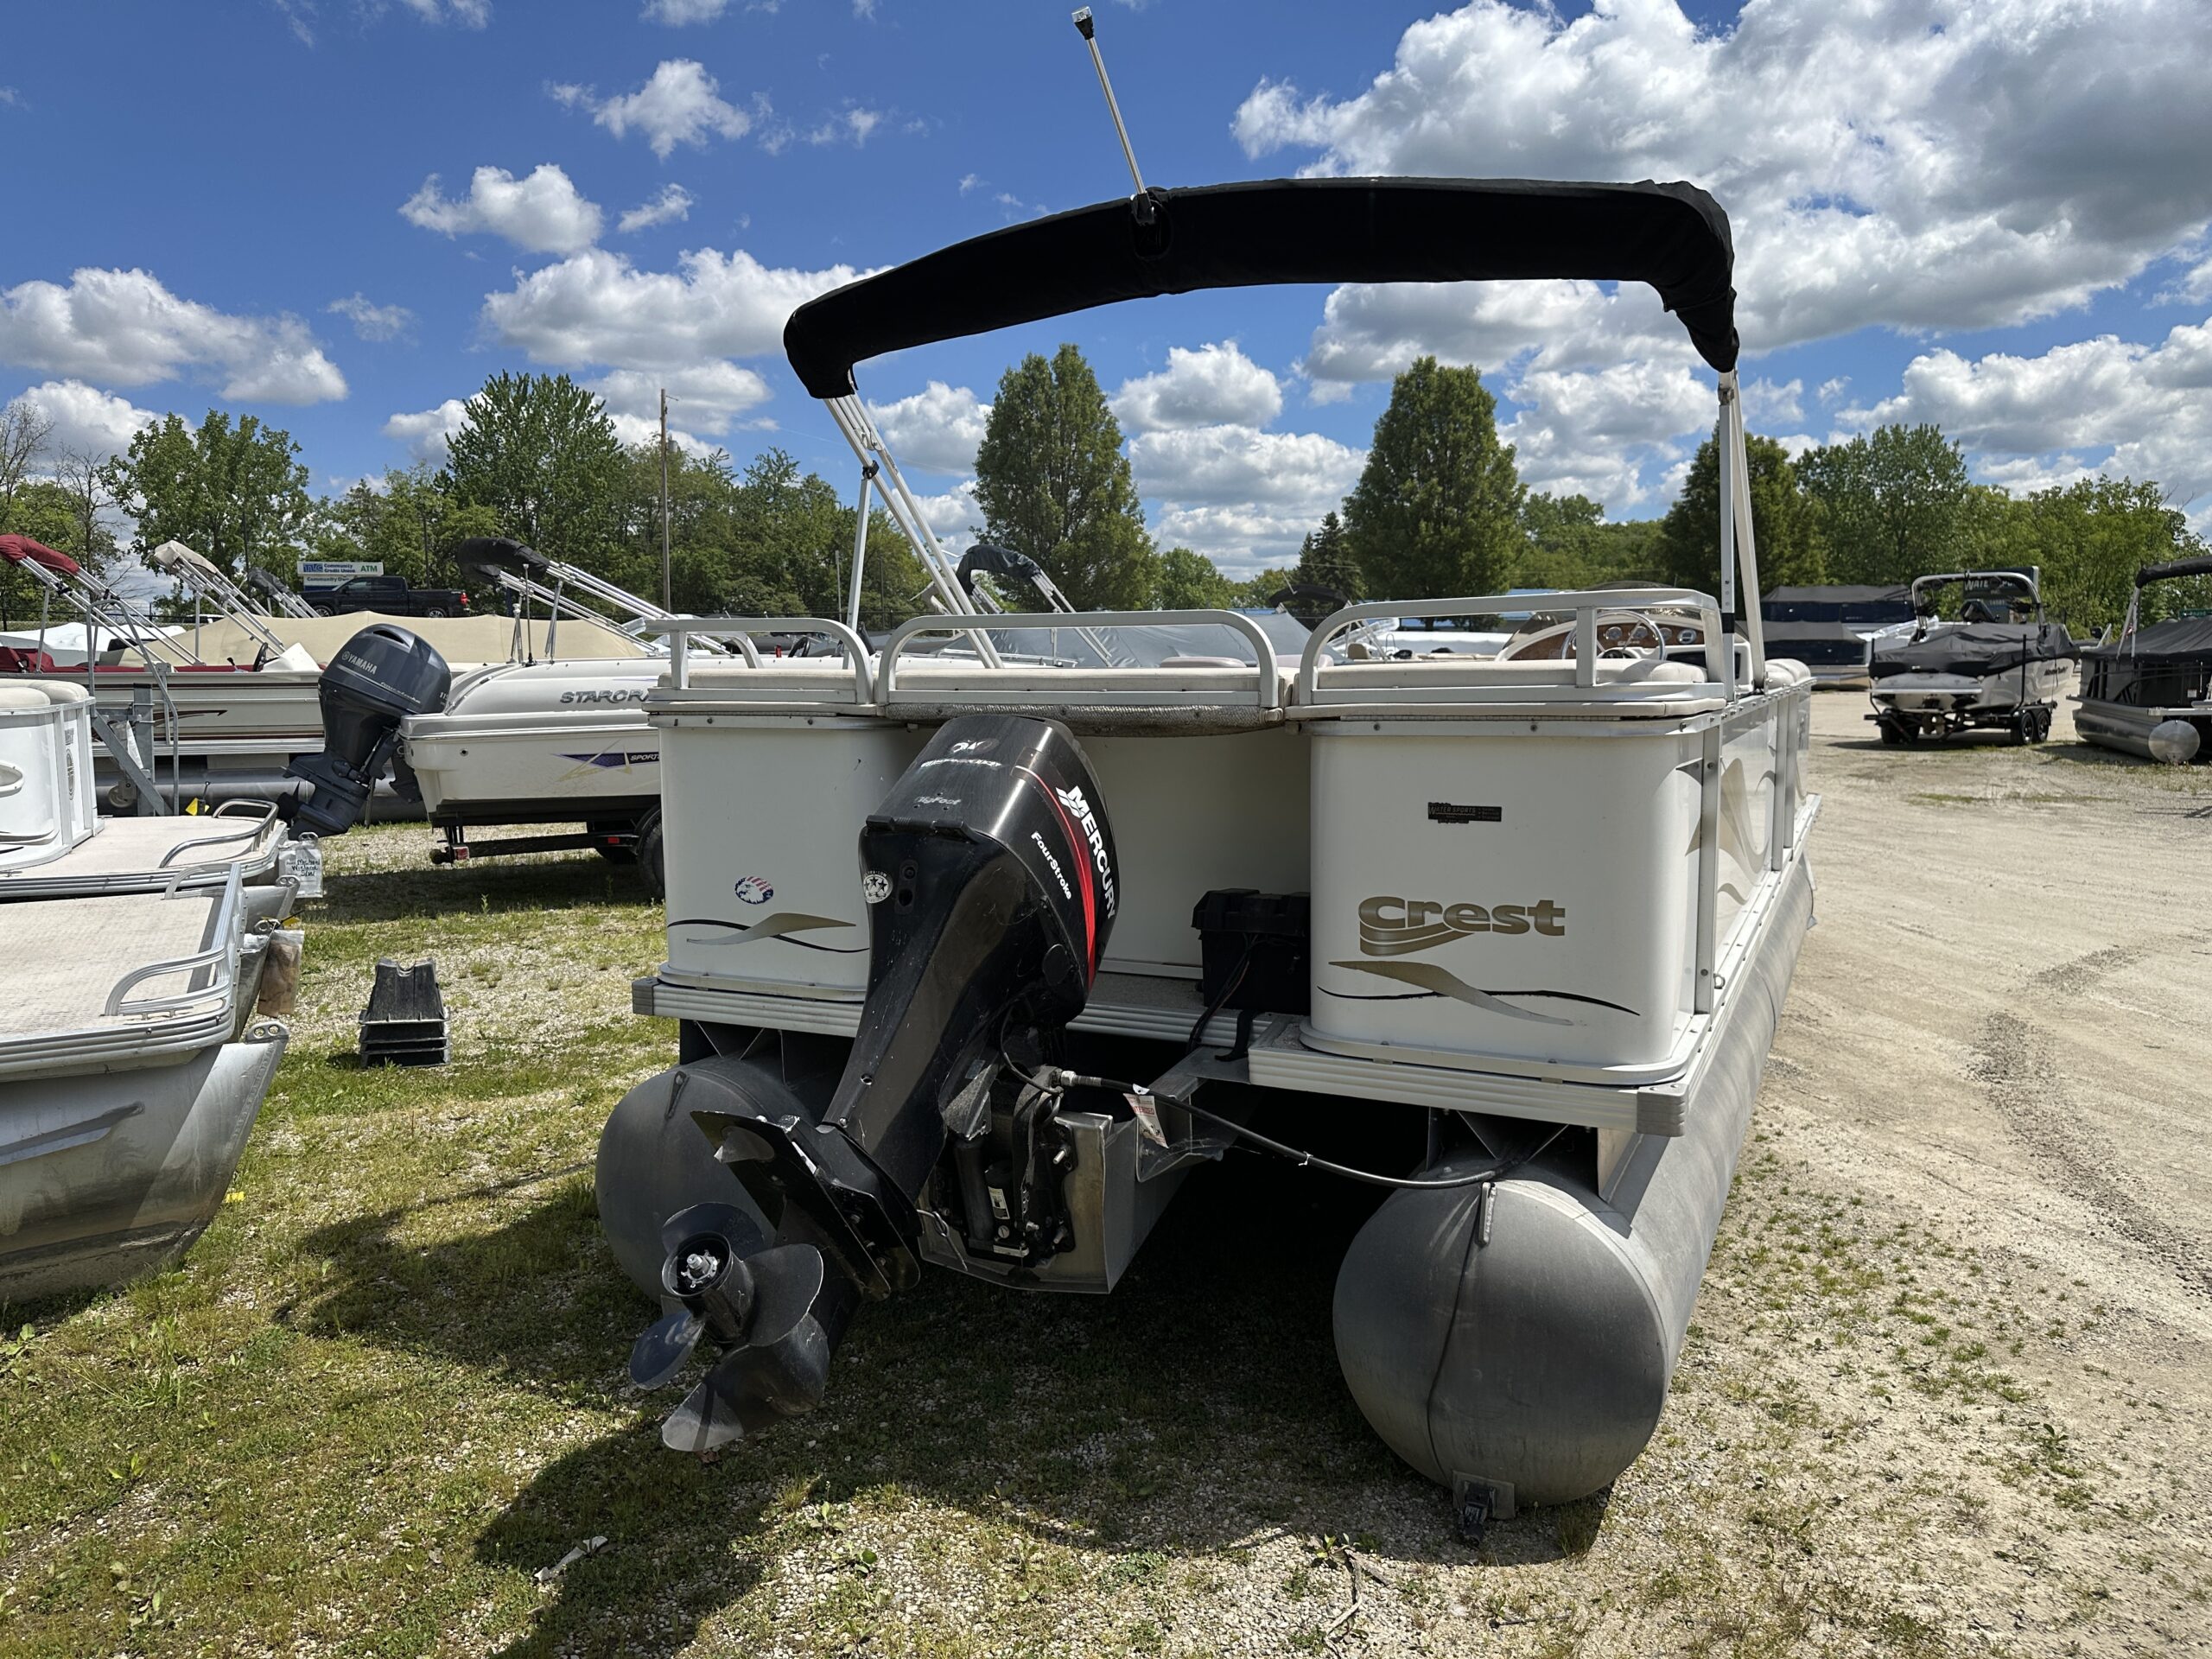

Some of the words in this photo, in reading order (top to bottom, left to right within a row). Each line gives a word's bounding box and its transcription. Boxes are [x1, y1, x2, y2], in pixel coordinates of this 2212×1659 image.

[348, 654, 378, 674] YAMAHA
[1031, 830, 1072, 899] FourStroke
[1056, 785, 1116, 919] MERCURY
[1358, 896, 1566, 937] Crest
